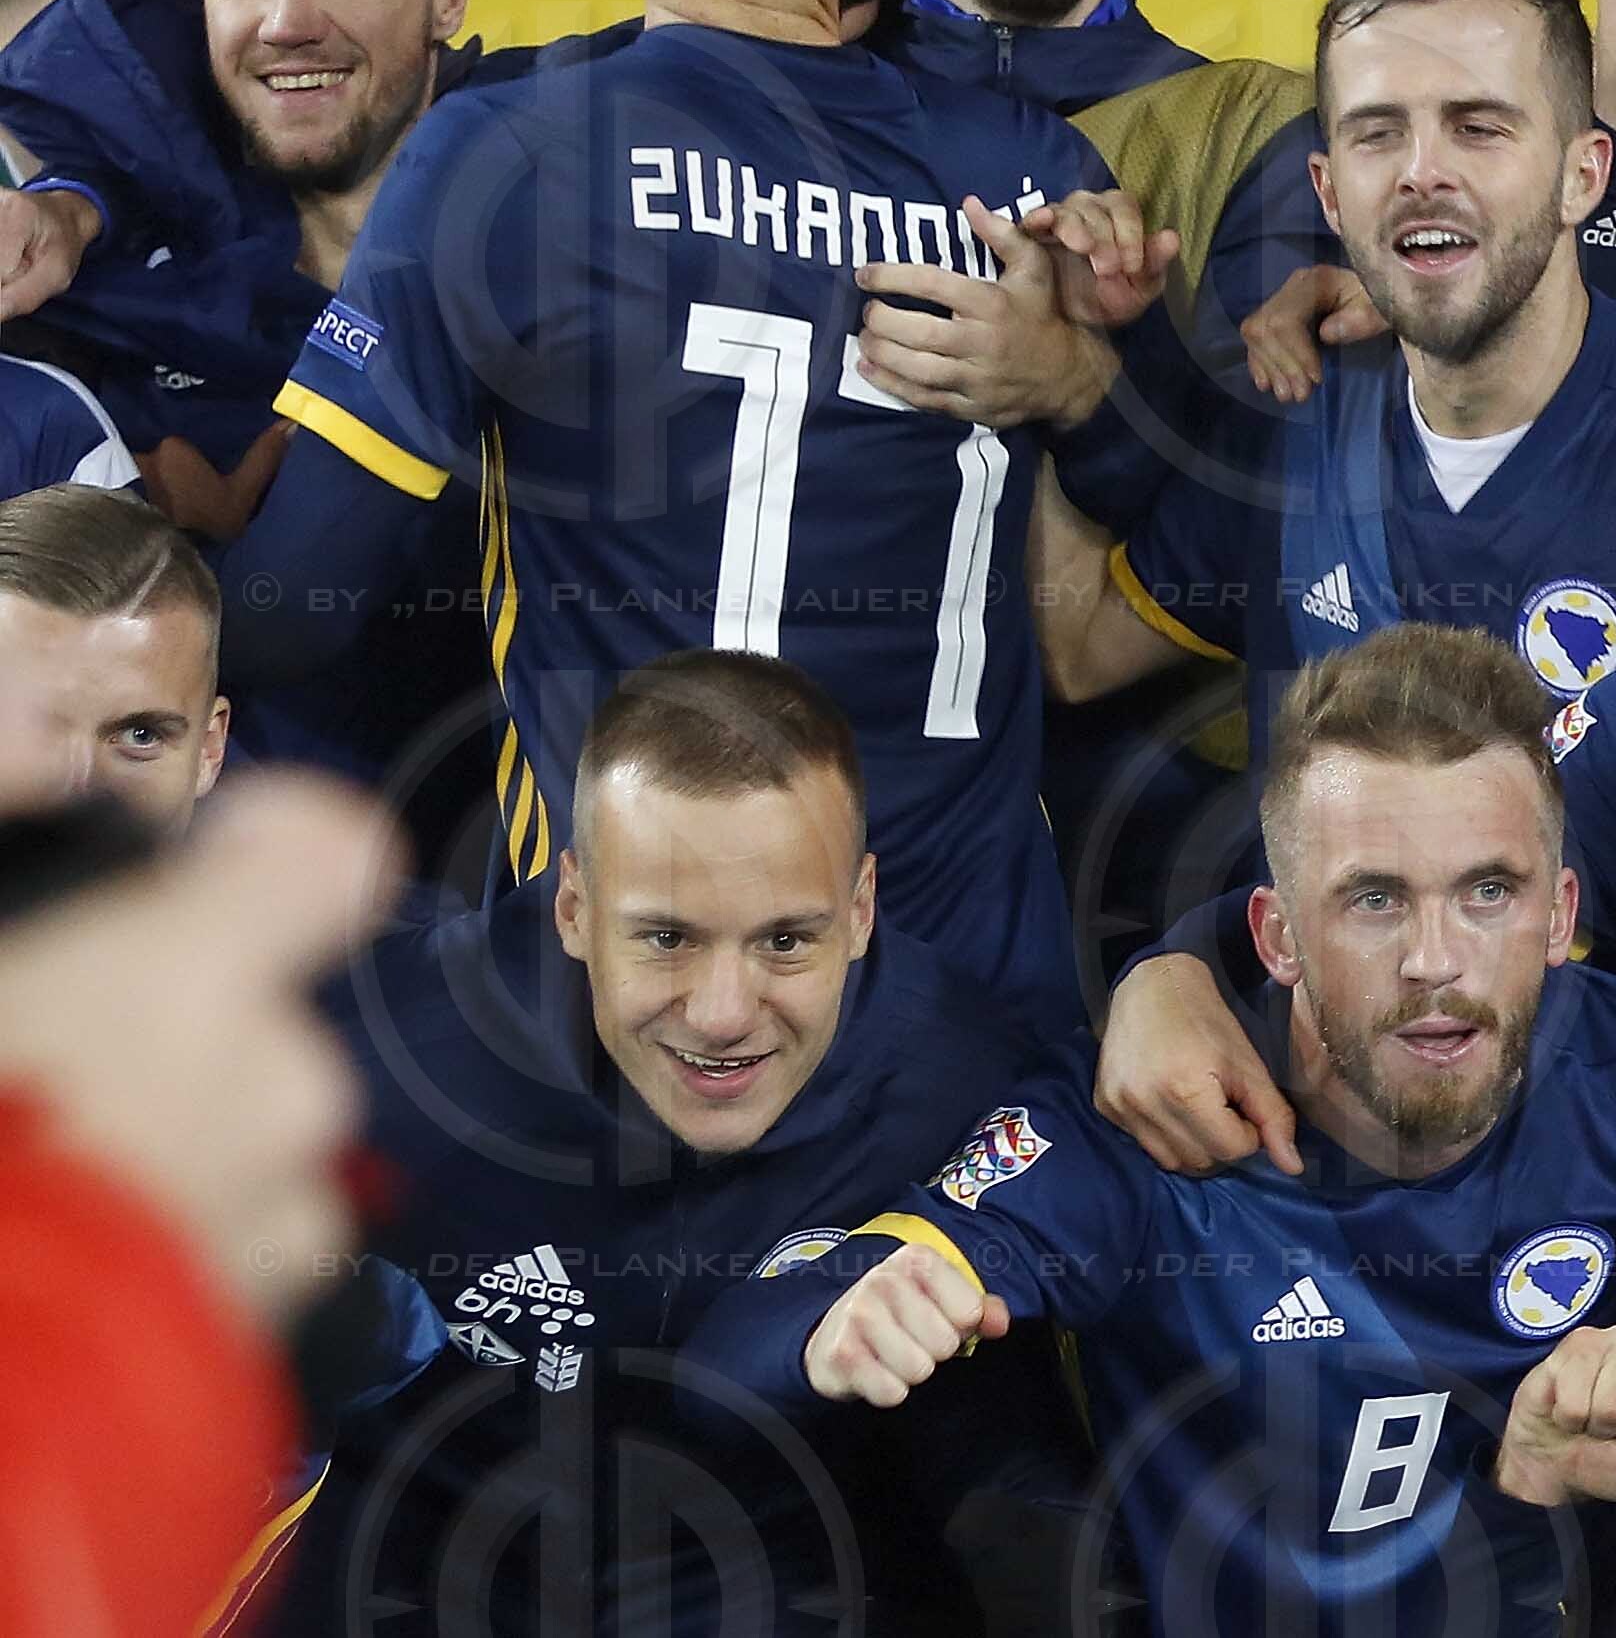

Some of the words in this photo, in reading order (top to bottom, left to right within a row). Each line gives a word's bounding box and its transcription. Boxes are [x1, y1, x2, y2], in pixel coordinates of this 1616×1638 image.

[630, 146, 1046, 283] ZUKANO
[1302, 591, 1360, 635] adidas
[478, 1272, 585, 1306] adidas
[1252, 1315, 1346, 1343] adidas
[1327, 1390, 1452, 1533] 8
